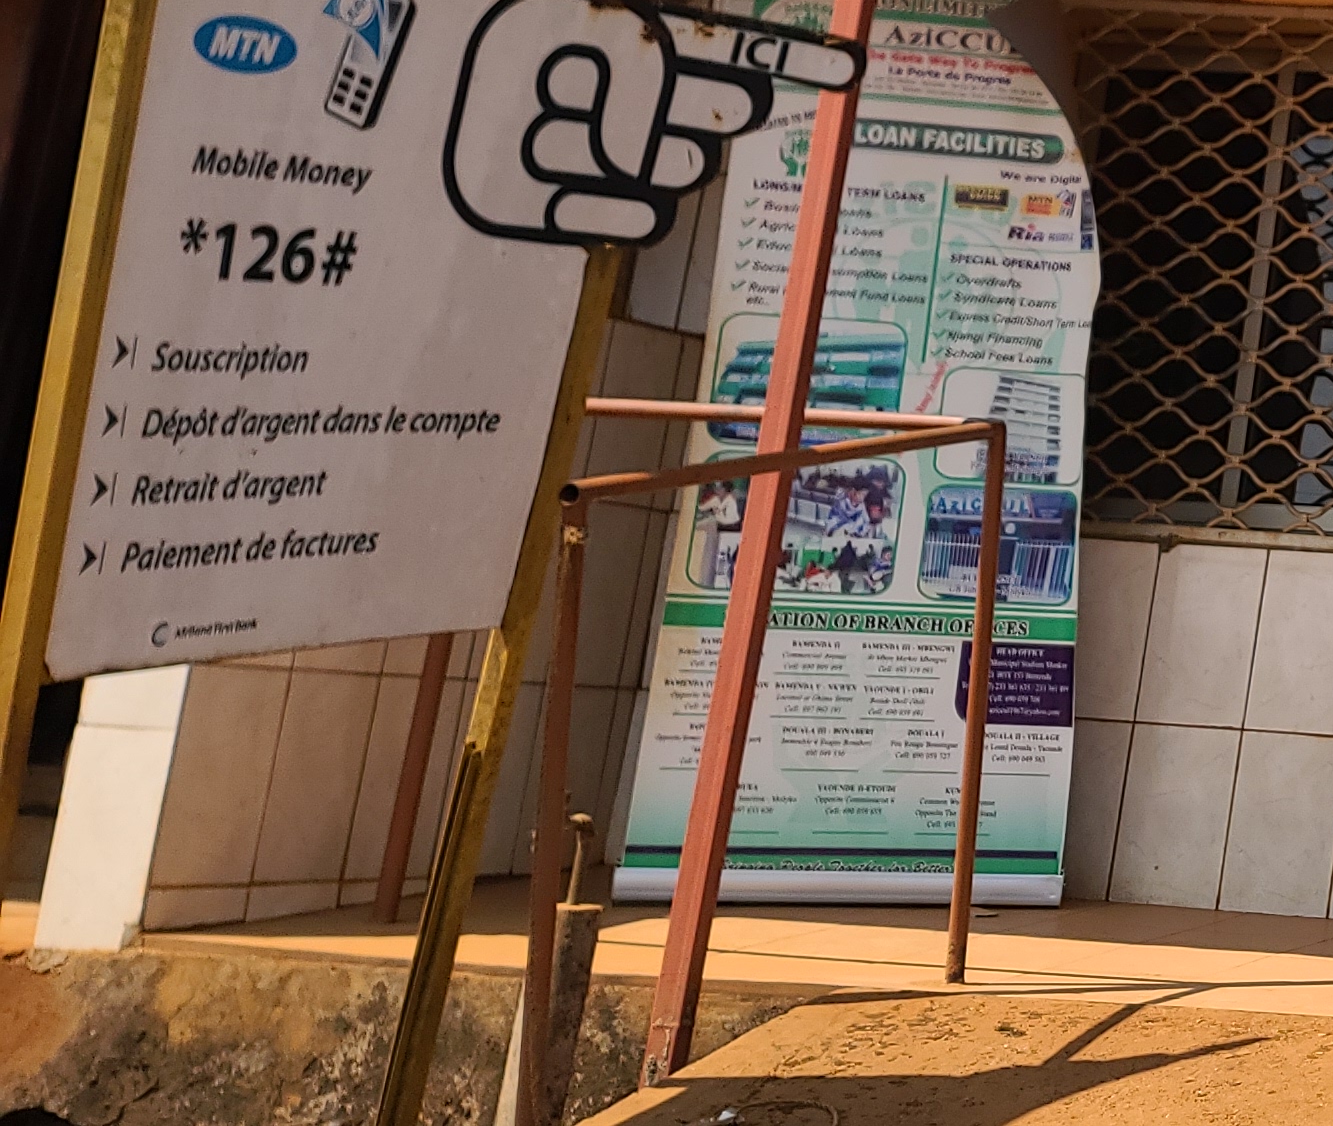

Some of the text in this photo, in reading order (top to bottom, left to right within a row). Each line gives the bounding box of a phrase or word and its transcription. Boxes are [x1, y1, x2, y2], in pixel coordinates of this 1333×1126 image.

[208, 24, 281, 65] MTN
[730, 31, 790, 73] ICI
[854, 123, 1046, 159] LOAN FACILITIES
[191, 144, 373, 195] Mobile Money
[1000, 169, 1022, 181] We
[847, 187, 926, 203] TERM LOANS
[950, 253, 1072, 272] SPECIAL OPERATIONS
[956, 273, 1022, 289] Overdrafts
[954, 291, 1058, 310] Syndicate Loans
[949, 310, 1076, 329] Express Credit/Short Term
[947, 329, 1043, 349] Njangi Financing
[151, 340, 310, 380] Souscription
[944, 347, 1053, 366] School Fees Loans
[141, 403, 500, 446] Dépôt d'argent dans le compte
[131, 469, 327, 506] Retrait d'argent
[120, 527, 380, 573] Paiement de factures
[766, 610, 1029, 636] ATION OF BRANCH OFCES
[828, 860, 884, 872] Together
